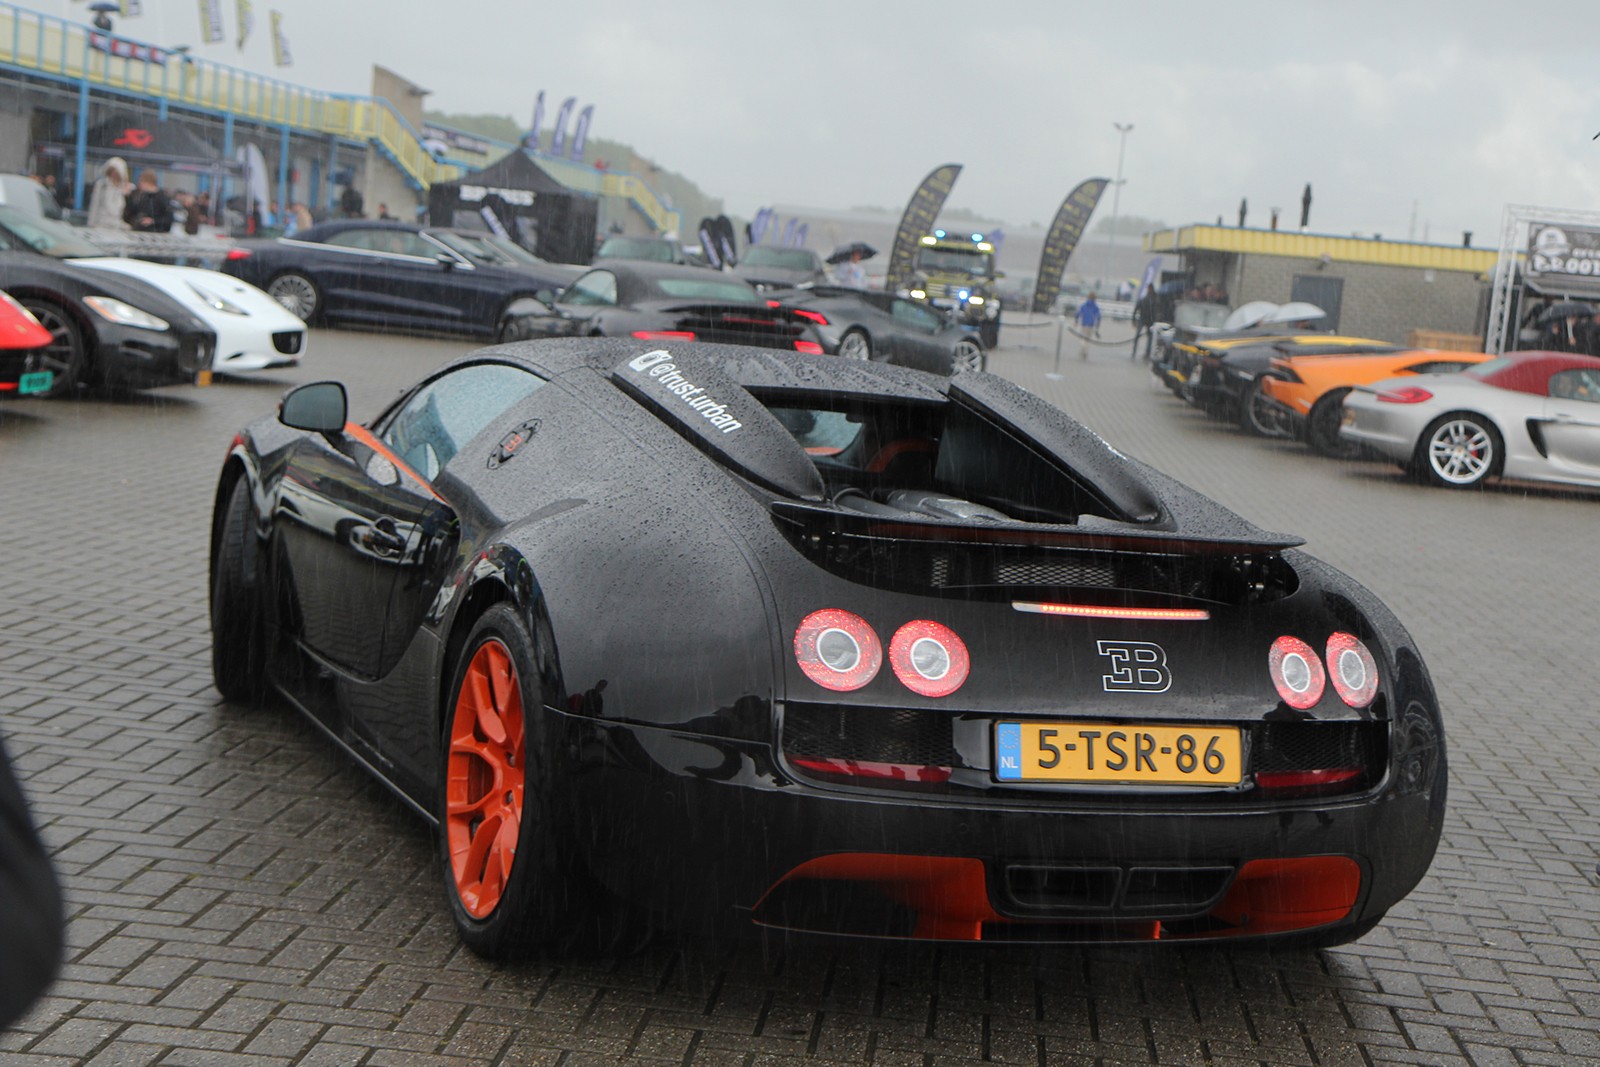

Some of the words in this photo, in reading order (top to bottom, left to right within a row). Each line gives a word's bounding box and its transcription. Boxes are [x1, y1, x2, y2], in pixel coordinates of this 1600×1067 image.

[649, 363, 743, 434] @trust.urban
[1001, 756, 1018, 769] NL
[1038, 729, 1225, 775] 5-TSR-86
